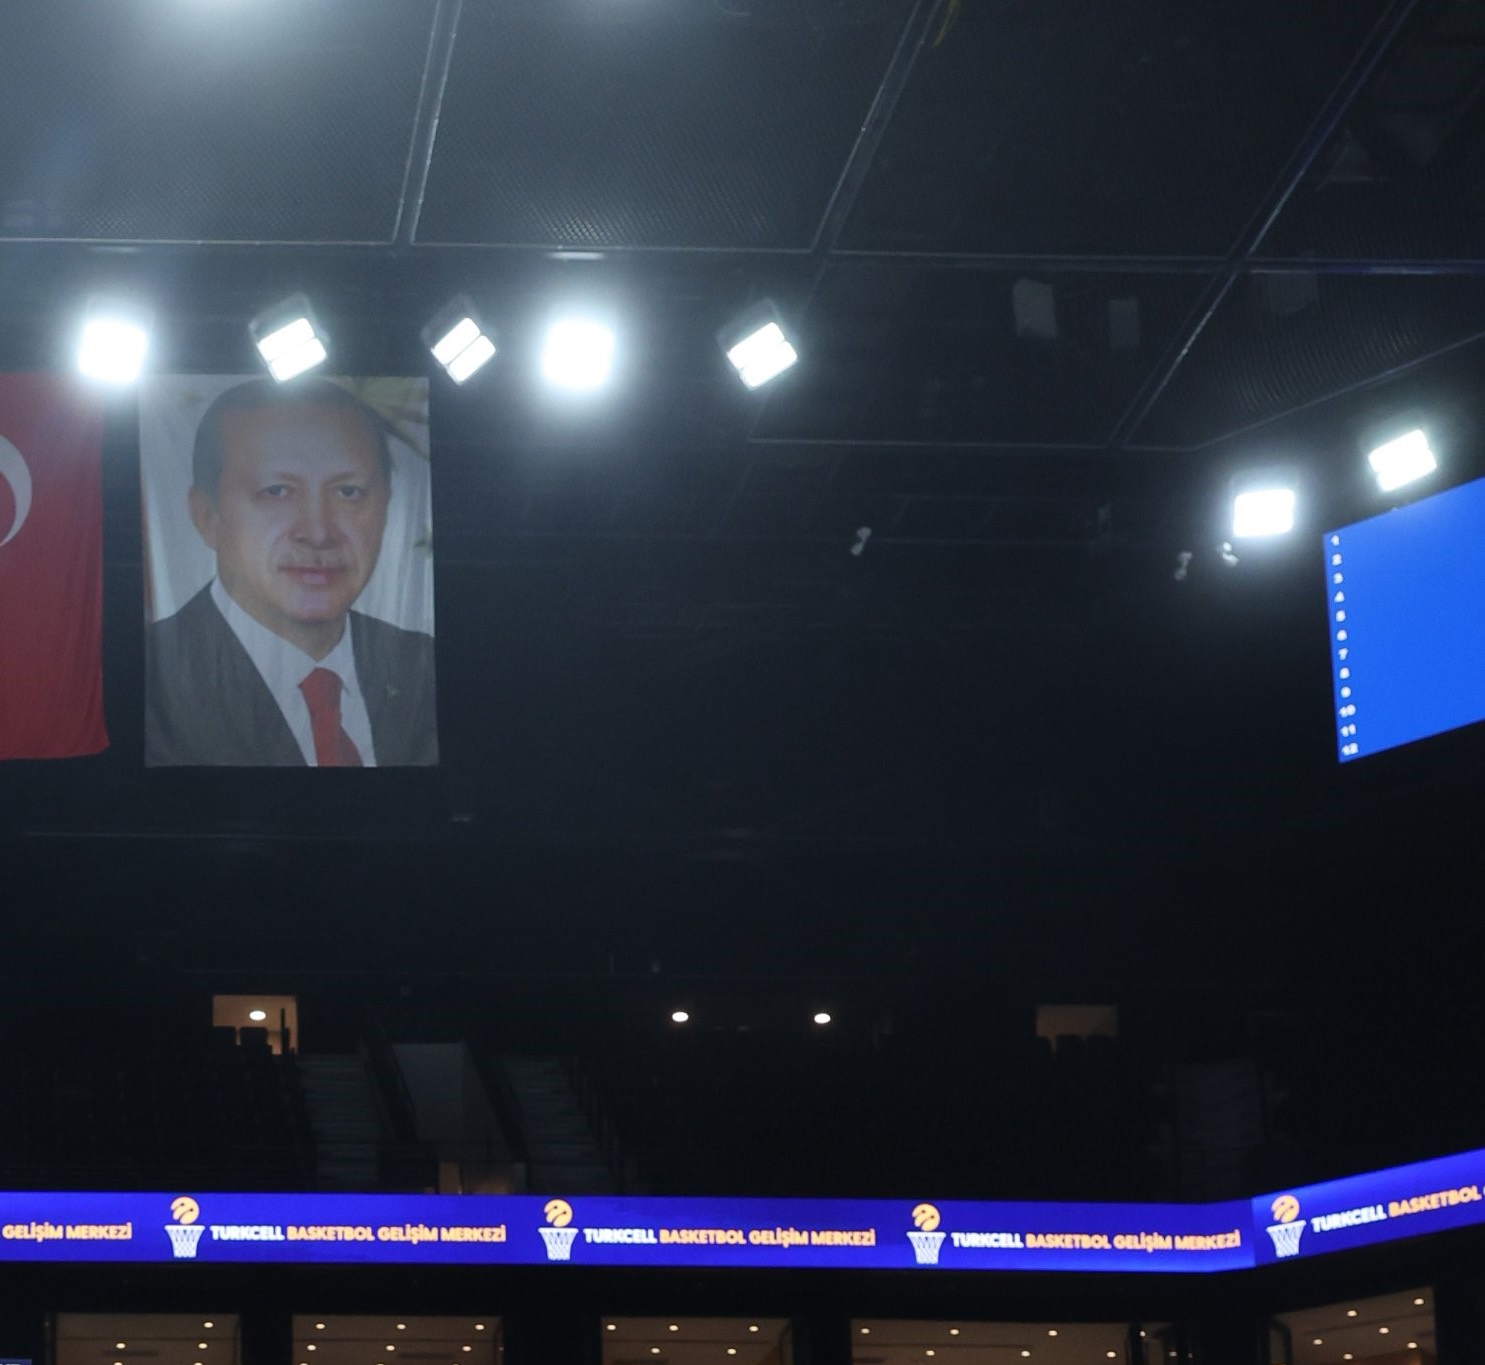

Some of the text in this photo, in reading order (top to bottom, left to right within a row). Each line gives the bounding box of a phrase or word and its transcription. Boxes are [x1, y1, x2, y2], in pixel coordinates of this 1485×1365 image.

[1311, 1185, 1483, 1232] TURKCELL BASKETBOL
[2, 1221, 64, 1242] GELİŞİM
[66, 1222, 132, 1240] MERKEZİ
[210, 1224, 506, 1245] TURKCELL BASKETBOL GELİŞİM MERKEZİ
[583, 1227, 876, 1248] TURKCELL BASKETBOL GELİŞİM MERKEZİ
[951, 1229, 1241, 1253] TURKCELL BASKETBOL GELİŞİM MERKEZİ
